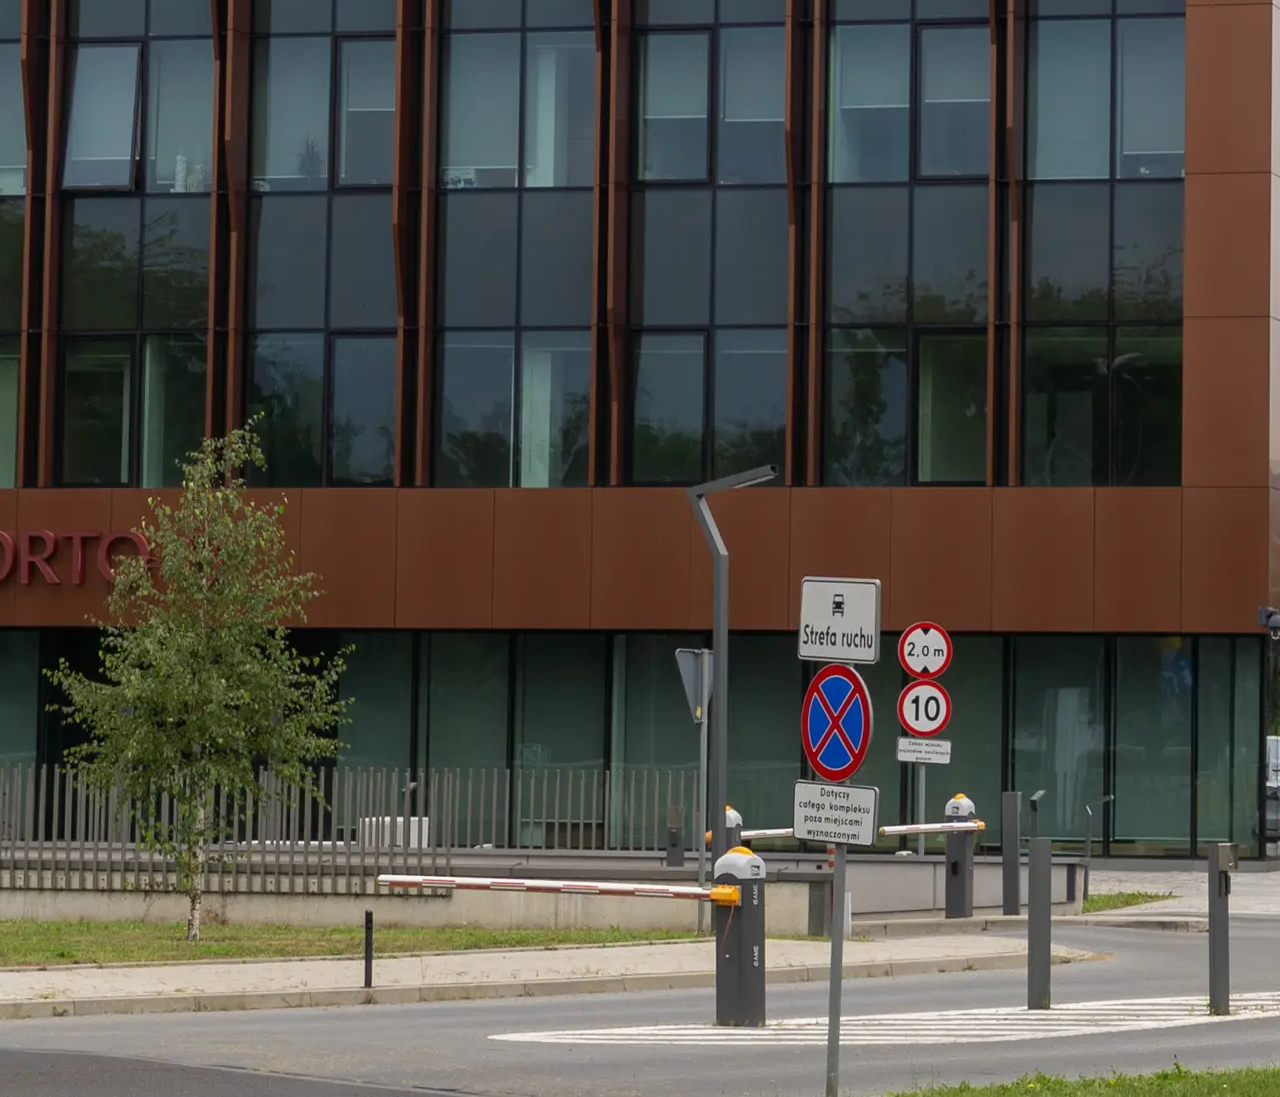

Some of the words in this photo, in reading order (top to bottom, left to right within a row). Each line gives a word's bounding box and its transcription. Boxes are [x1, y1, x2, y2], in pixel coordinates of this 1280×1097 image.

[802, 623, 837, 646] Strefa
[841, 626, 873, 649] ruchu
[907, 642, 930, 659] 2,0
[933, 647, 945, 658] m
[910, 695, 940, 722] 10
[820, 787, 850, 801] Dotyczy
[798, 799, 826, 812] całego
[829, 802, 871, 815] kompleksu
[804, 814, 823, 824] poza
[824, 815, 863, 827] miejscami
[806, 829, 861, 842] wyznaczonymi
